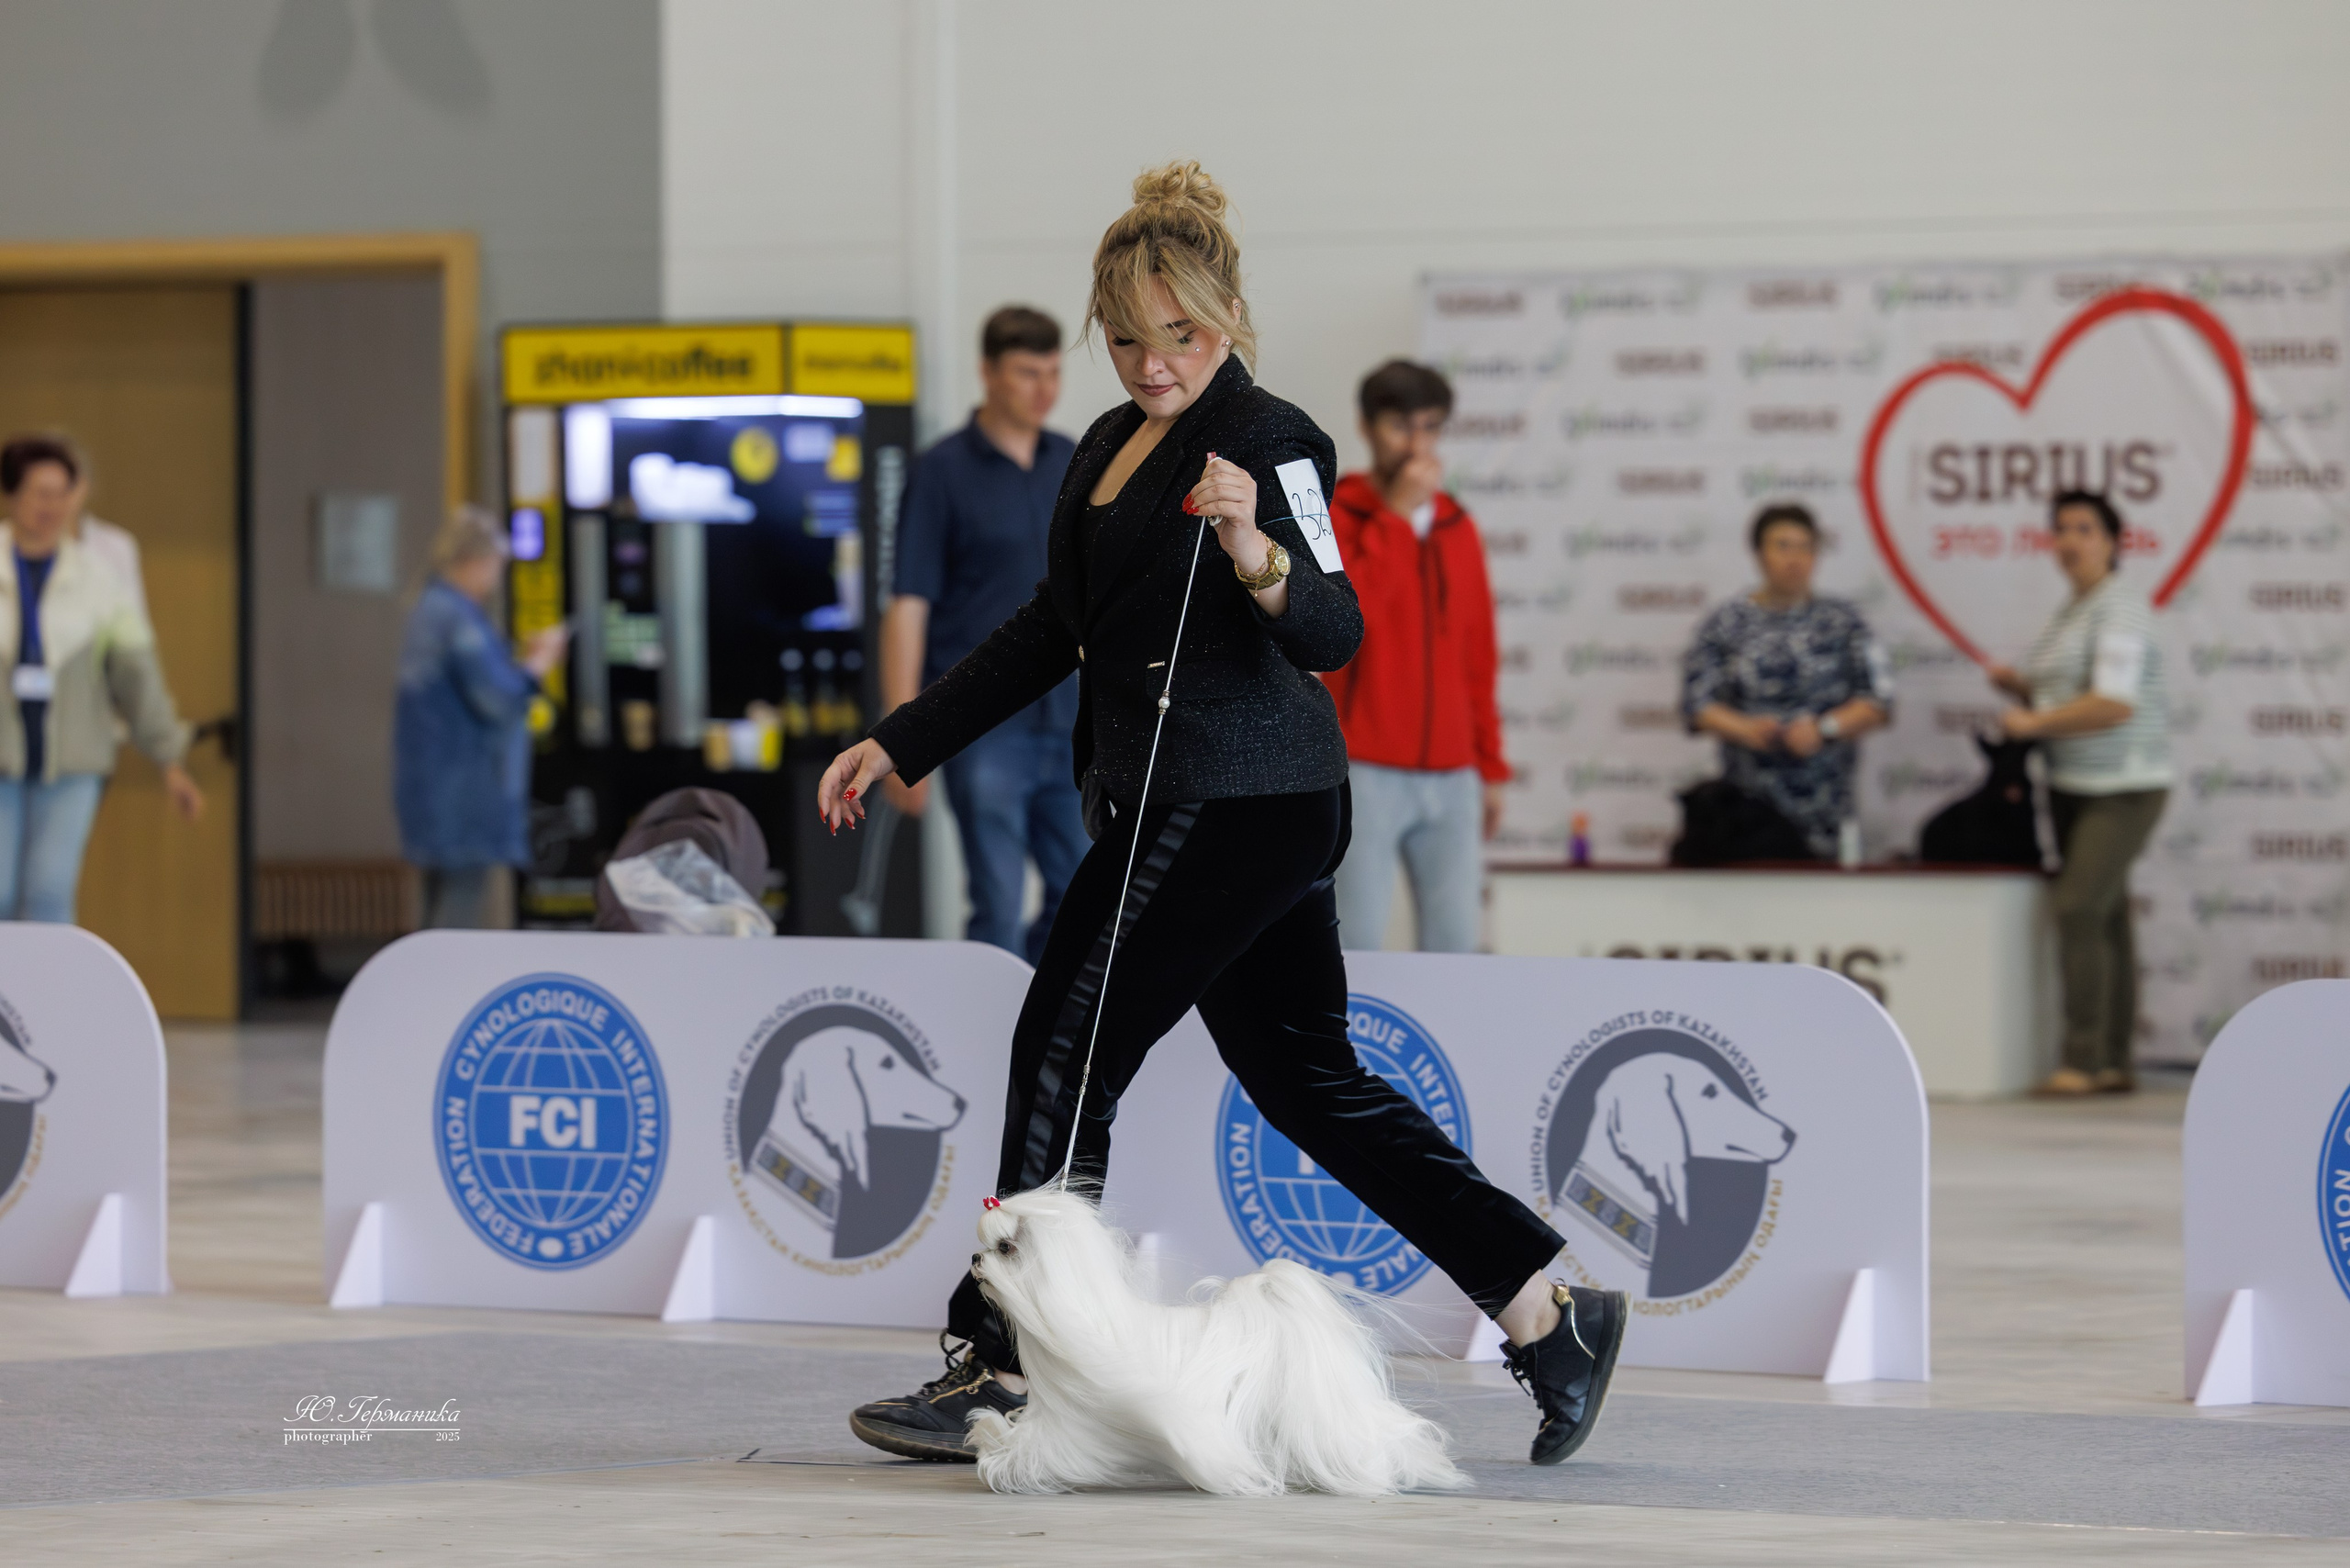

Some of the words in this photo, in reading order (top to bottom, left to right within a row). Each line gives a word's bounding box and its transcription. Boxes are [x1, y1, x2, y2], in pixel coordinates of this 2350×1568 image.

[1930, 441, 2162, 504] SIRIUS
[455, 988, 610, 1081] CYNOLOGIQUE
[1548, 1009, 1648, 1092] CYNOLOGISTS
[1651, 1009, 1674, 1026] OF
[1678, 1013, 1770, 1102] KAZAKHSTAN
[509, 1094, 598, 1148] FCI
[569, 1029, 658, 1258] INTERNATIONALE
[1536, 1092, 1557, 1121] OF
[446, 1097, 535, 1254] FEDERATION
[1529, 1126, 1545, 1192] UNION
